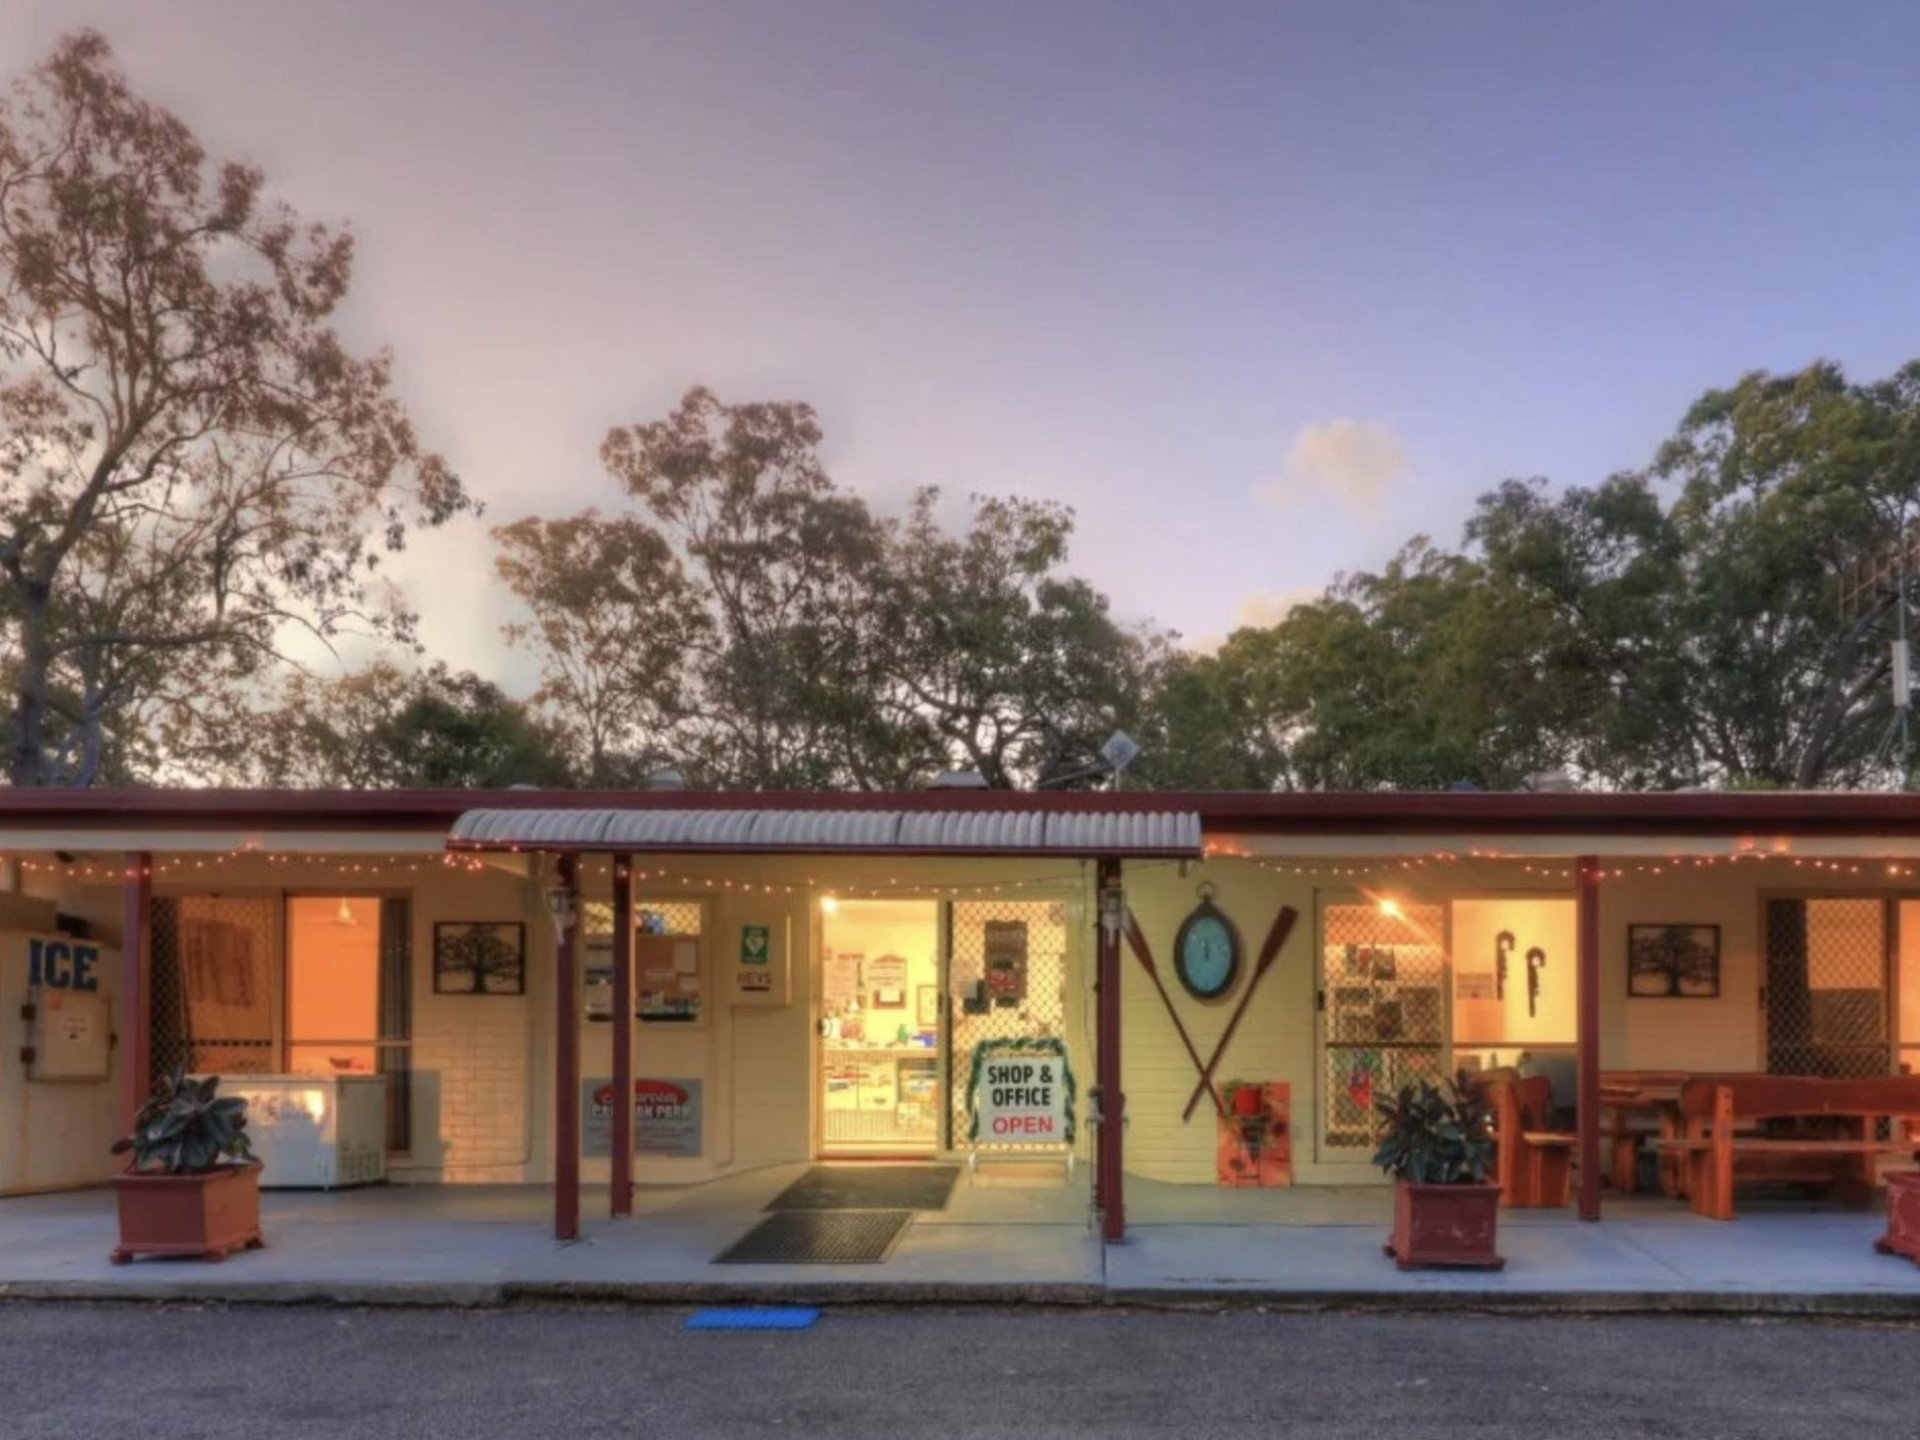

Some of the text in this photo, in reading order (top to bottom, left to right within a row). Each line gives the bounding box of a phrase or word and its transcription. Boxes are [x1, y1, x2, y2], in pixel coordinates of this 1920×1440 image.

[28, 938, 98, 991] ICE
[987, 1064, 1053, 1085] SHOP &
[992, 1086, 1052, 1108] OFFICE
[992, 1114, 1054, 1135] OPEN
